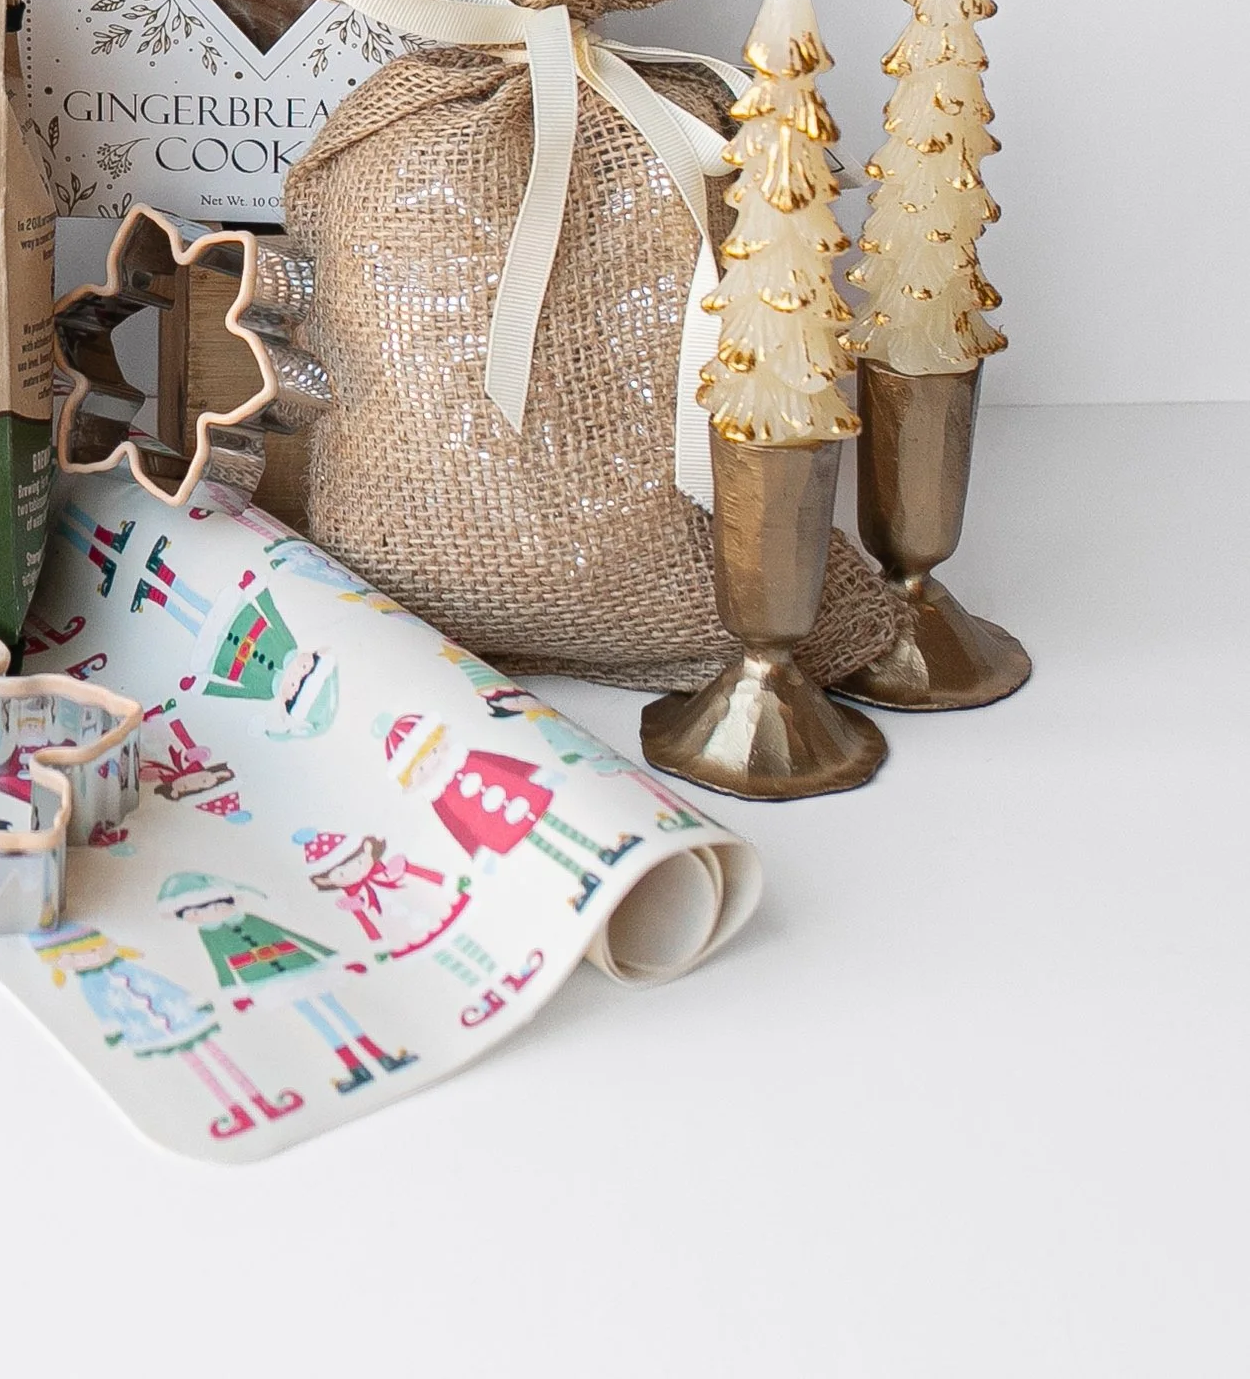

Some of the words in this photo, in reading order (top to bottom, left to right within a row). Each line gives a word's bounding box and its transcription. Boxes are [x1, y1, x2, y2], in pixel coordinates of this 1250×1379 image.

[63, 90, 336, 129] GINGERBREA
[154, 136, 305, 174] COOK
[200, 194, 223, 206] Net
[227, 195, 248, 207] Wt.
[253, 197, 266, 208] 10
